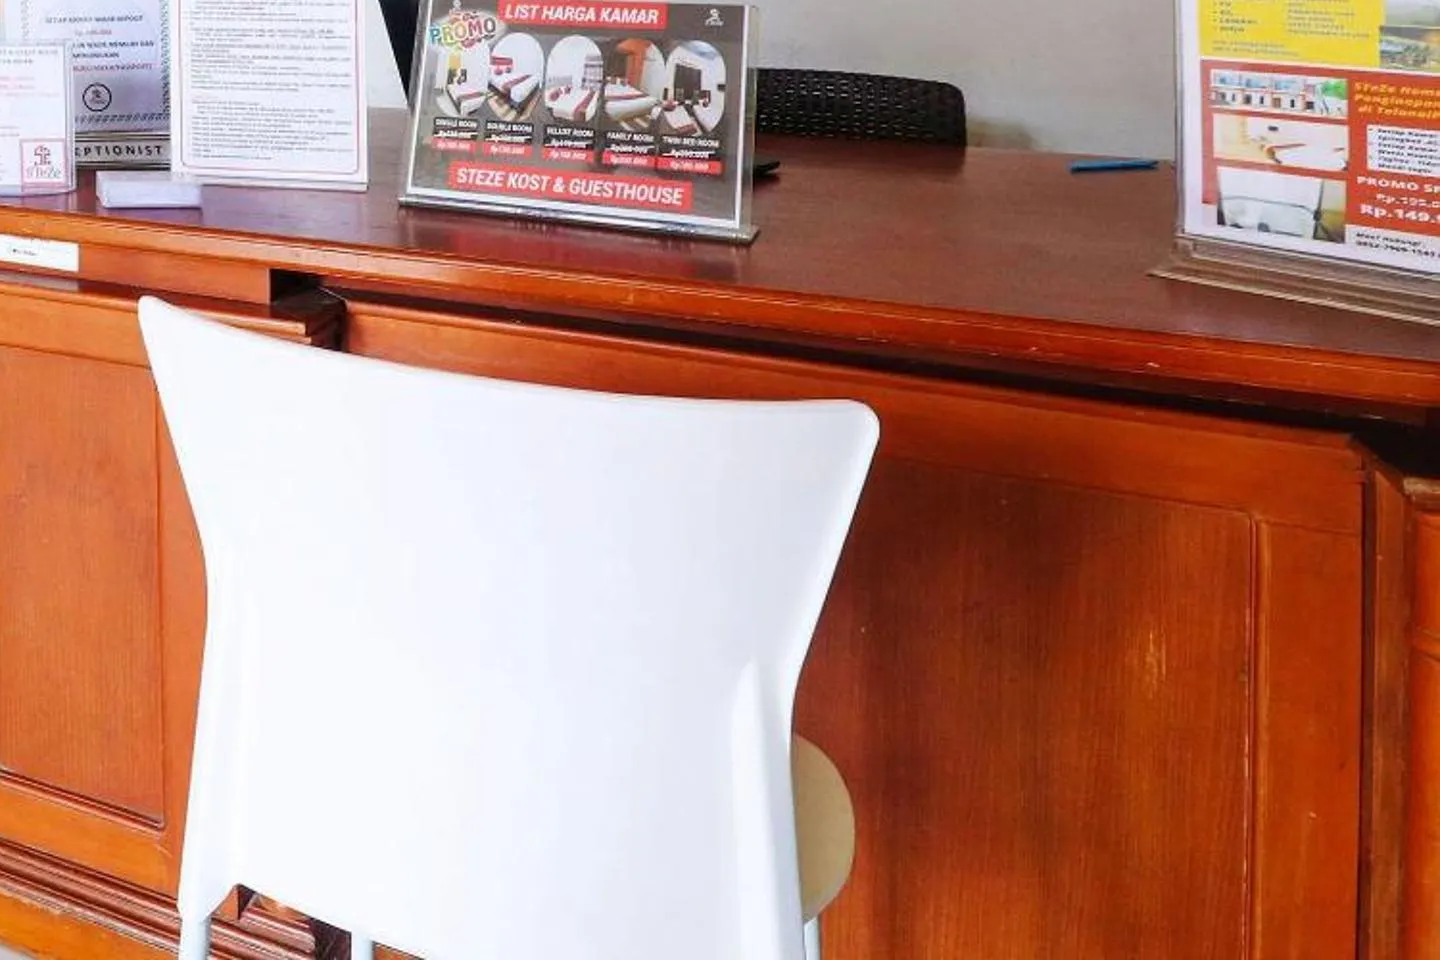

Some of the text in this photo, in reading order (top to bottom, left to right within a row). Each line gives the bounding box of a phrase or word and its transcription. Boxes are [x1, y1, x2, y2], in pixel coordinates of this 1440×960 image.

[505, 2, 659, 24] LIST HARGA KAMAR
[429, 17, 497, 45] PROMO
[456, 167, 685, 206] STEZE KOST & GUESTHOUSE
[1357, 175, 1420, 191] PROMO
